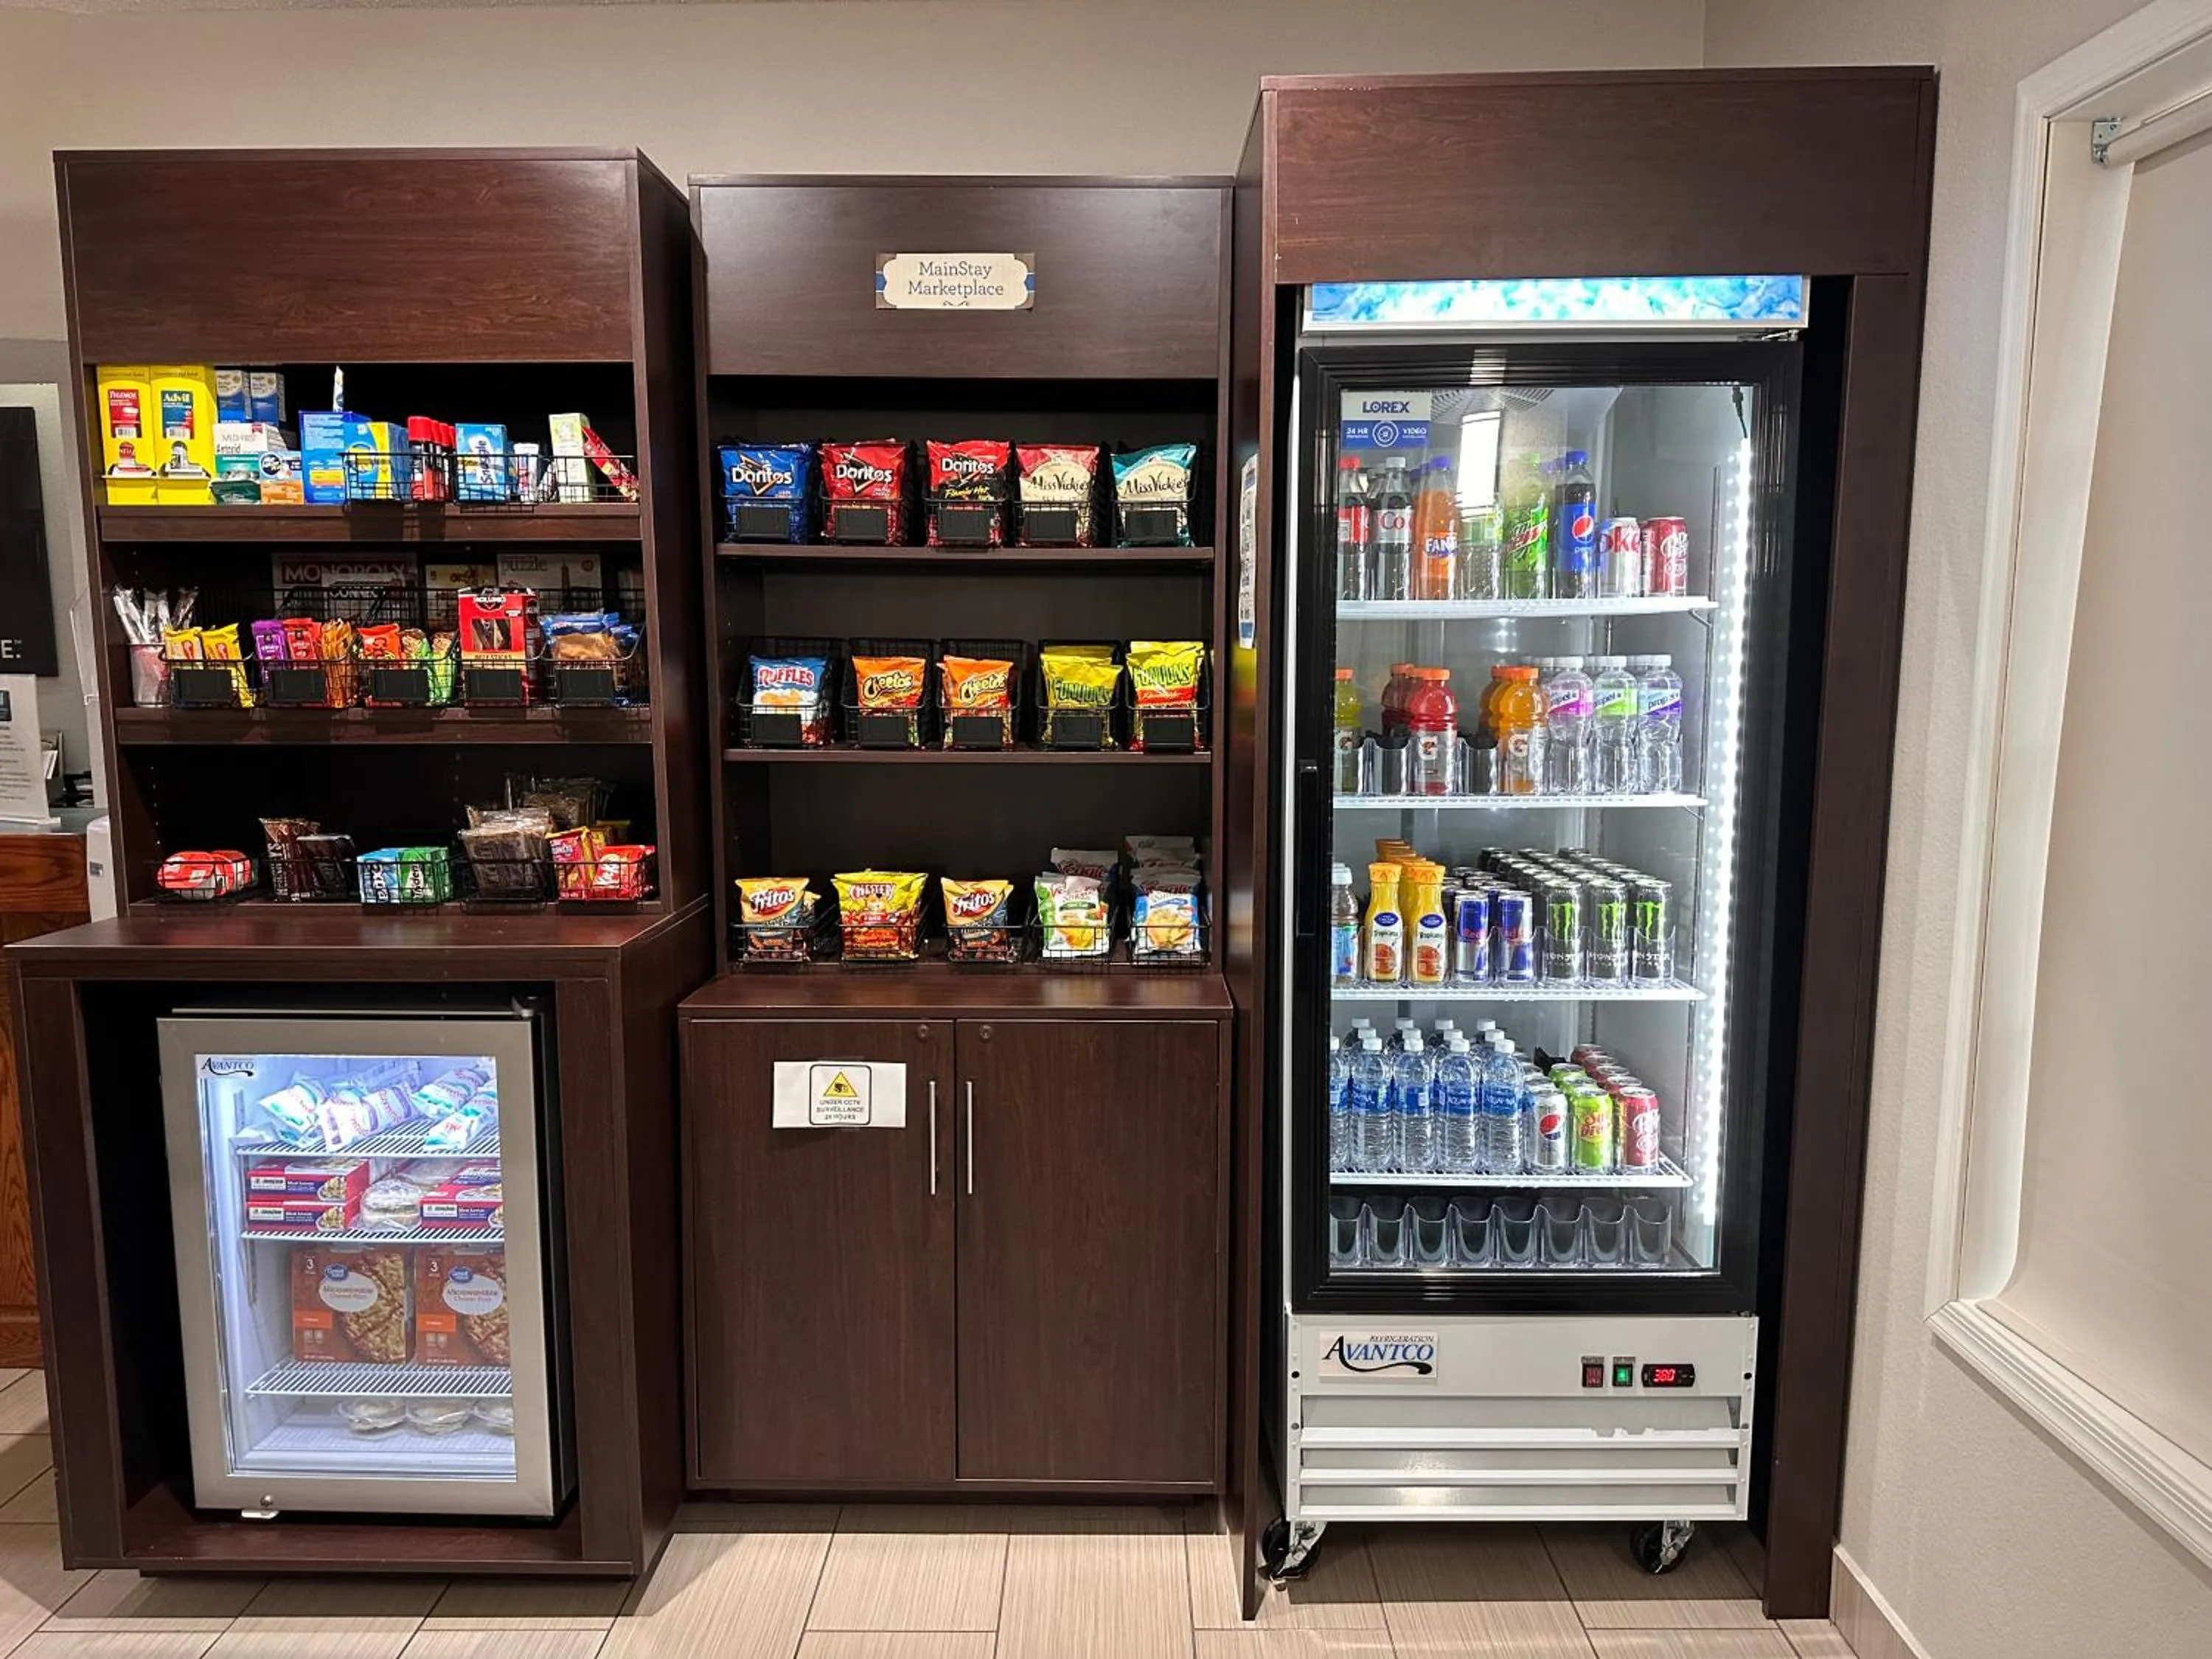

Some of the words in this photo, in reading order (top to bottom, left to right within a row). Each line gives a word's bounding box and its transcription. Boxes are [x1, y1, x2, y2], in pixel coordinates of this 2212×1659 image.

[919, 260, 992, 279] MainStay
[908, 279, 1004, 298] Marketplace
[164, 392, 189, 403] Advil
[1363, 401, 1410, 413] LOREX
[731, 466, 793, 485] Doritos
[835, 463, 893, 483] Doritos
[942, 457, 995, 475] Doritos
[1028, 475, 1056, 492] Miss
[1124, 478, 1151, 495] Miss
[758, 666, 815, 686] RUFFLES
[862, 672, 914, 699] Cheetos
[959, 674, 1008, 703] Cheetos
[748, 889, 796, 914] Fritos
[952, 891, 995, 915] Fritos
[202, 1057, 254, 1072] AVANTCO
[306, 1259, 314, 1270] 3
[430, 1262, 438, 1273] 3
[1321, 1335, 1434, 1364] AVANTCO
